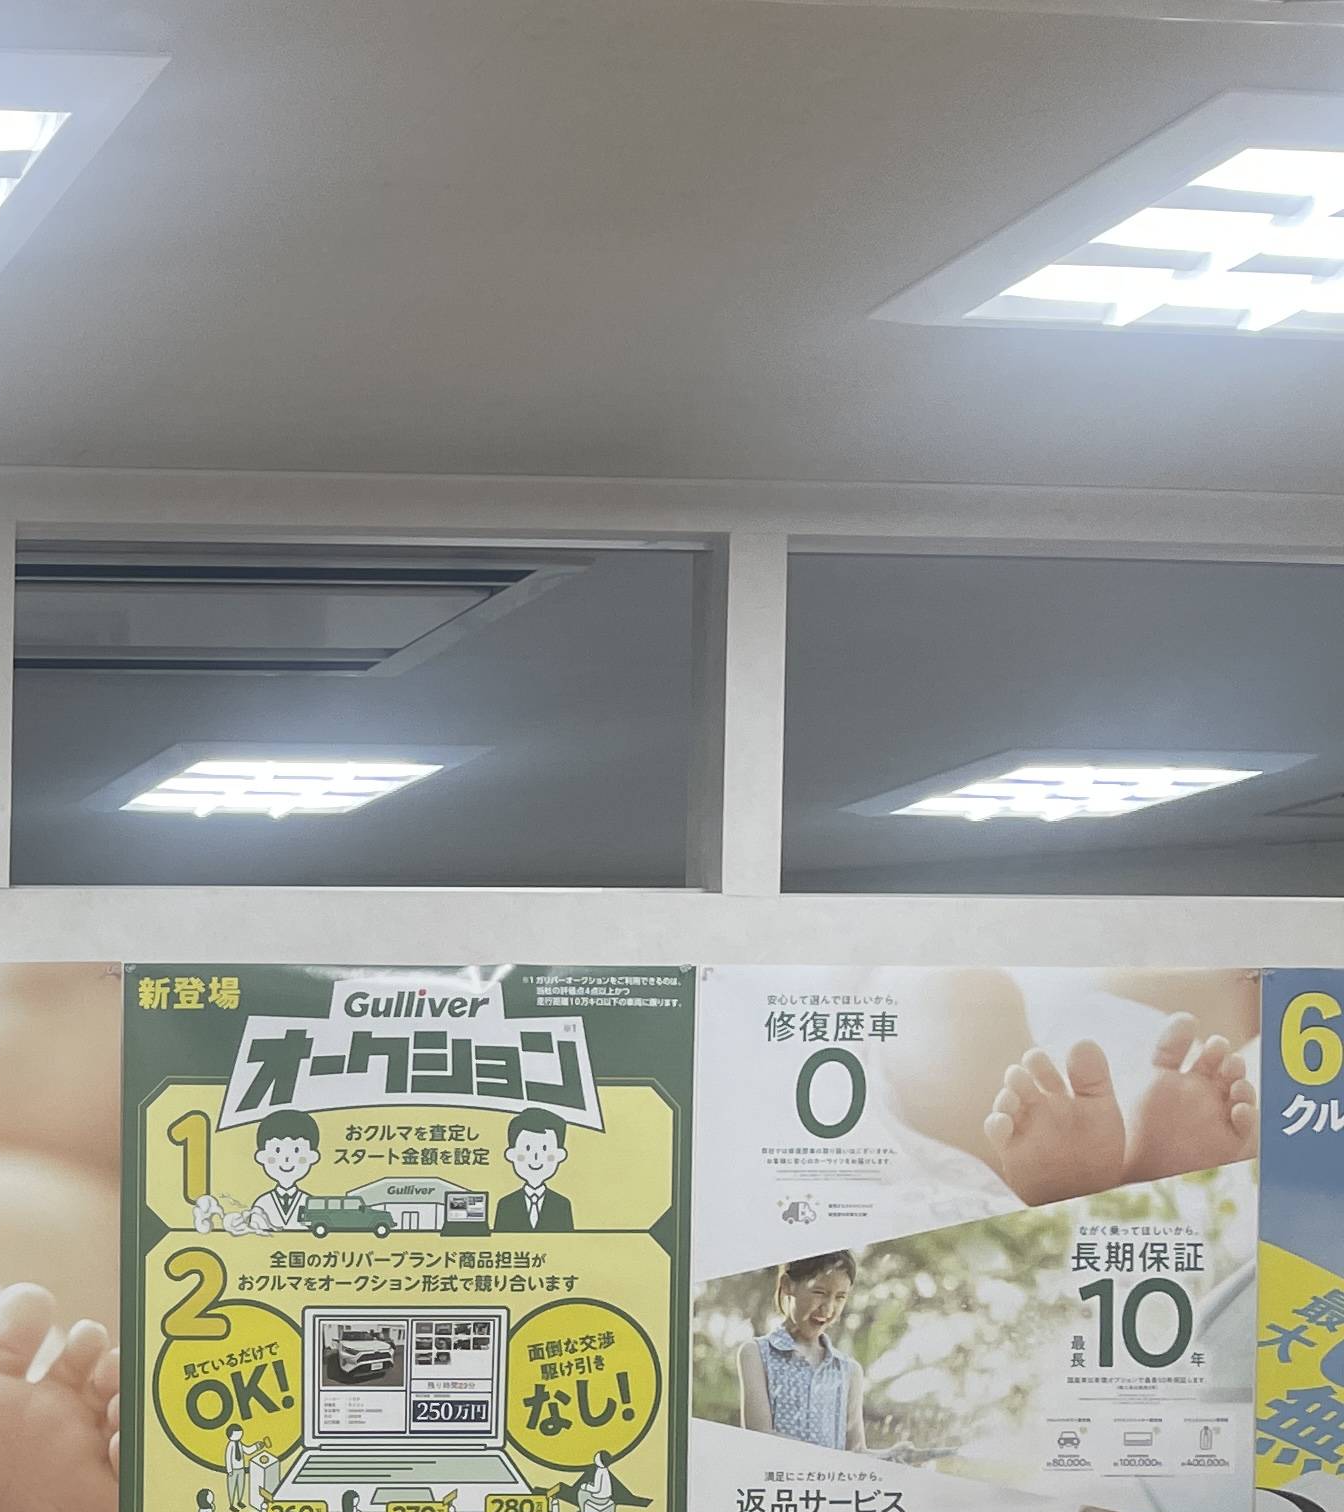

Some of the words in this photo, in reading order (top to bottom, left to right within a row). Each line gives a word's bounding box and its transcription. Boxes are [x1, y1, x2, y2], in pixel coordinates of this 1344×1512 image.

[138, 976, 241, 1010] 新登場
[343, 988, 490, 1020] Gulliver
[767, 994, 899, 1006] 安心して選んでほしいから。
[764, 1011, 899, 1043] 修復歴車
[1280, 990, 1344, 1087] 6
[235, 1029, 587, 1112] オークション
[795, 1046, 867, 1139] 0
[345, 1124, 480, 1142] おクルマを査定し
[166, 1109, 212, 1204] 1
[334, 1148, 490, 1166] スタート金額を設定
[387, 1184, 436, 1196] Gulliver
[1079, 1225, 1200, 1236] ながく乗ってほしいから。
[269, 1250, 547, 1270] 全国のガリバーブランド商品担当が
[1071, 1241, 1205, 1273] 長期保証
[161, 1246, 232, 1341] 2
[237, 1274, 579, 1294] おクルマをオークション形式で競り合います
[1070, 1335, 1086, 1368] 最長
[1078, 1277, 1193, 1369] 10
[1190, 1352, 1206, 1368] 年
[183, 1341, 281, 1382] 見ているだけで
[526, 1331, 617, 1363] 面倒な交渉
[541, 1353, 607, 1381] 駆け引き
[185, 1359, 295, 1432] OK!
[416, 1401, 487, 1421] 250万円
[523, 1371, 636, 1436] なし!
[764, 1471, 884, 1482] 満足にこだわりたいから。
